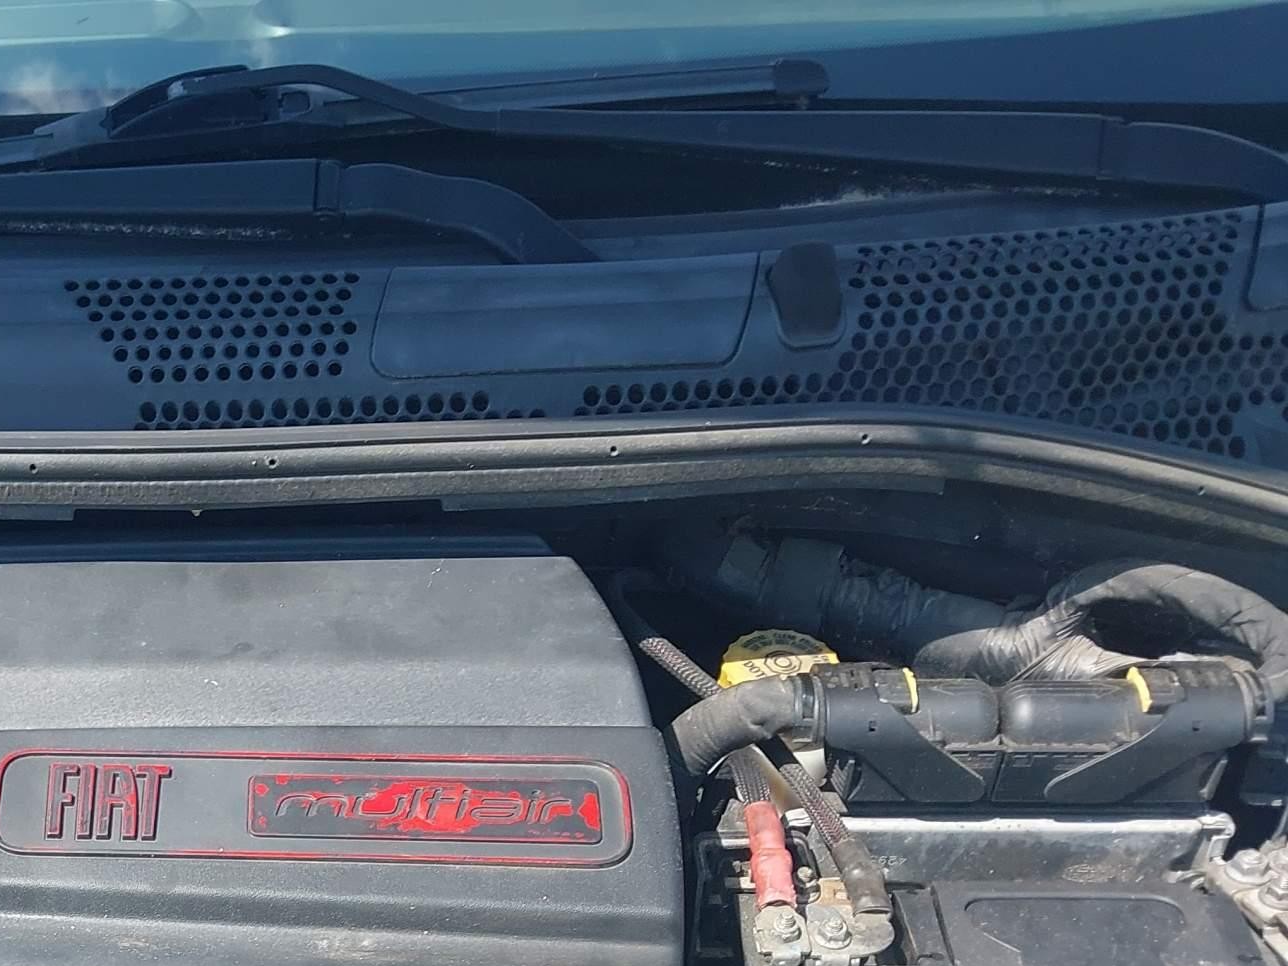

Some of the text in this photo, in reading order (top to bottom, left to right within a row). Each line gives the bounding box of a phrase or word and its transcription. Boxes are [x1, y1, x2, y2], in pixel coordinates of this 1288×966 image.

[743, 660, 767, 678] DOT
[44, 762, 173, 842] FIAT
[272, 787, 573, 825] multiair
